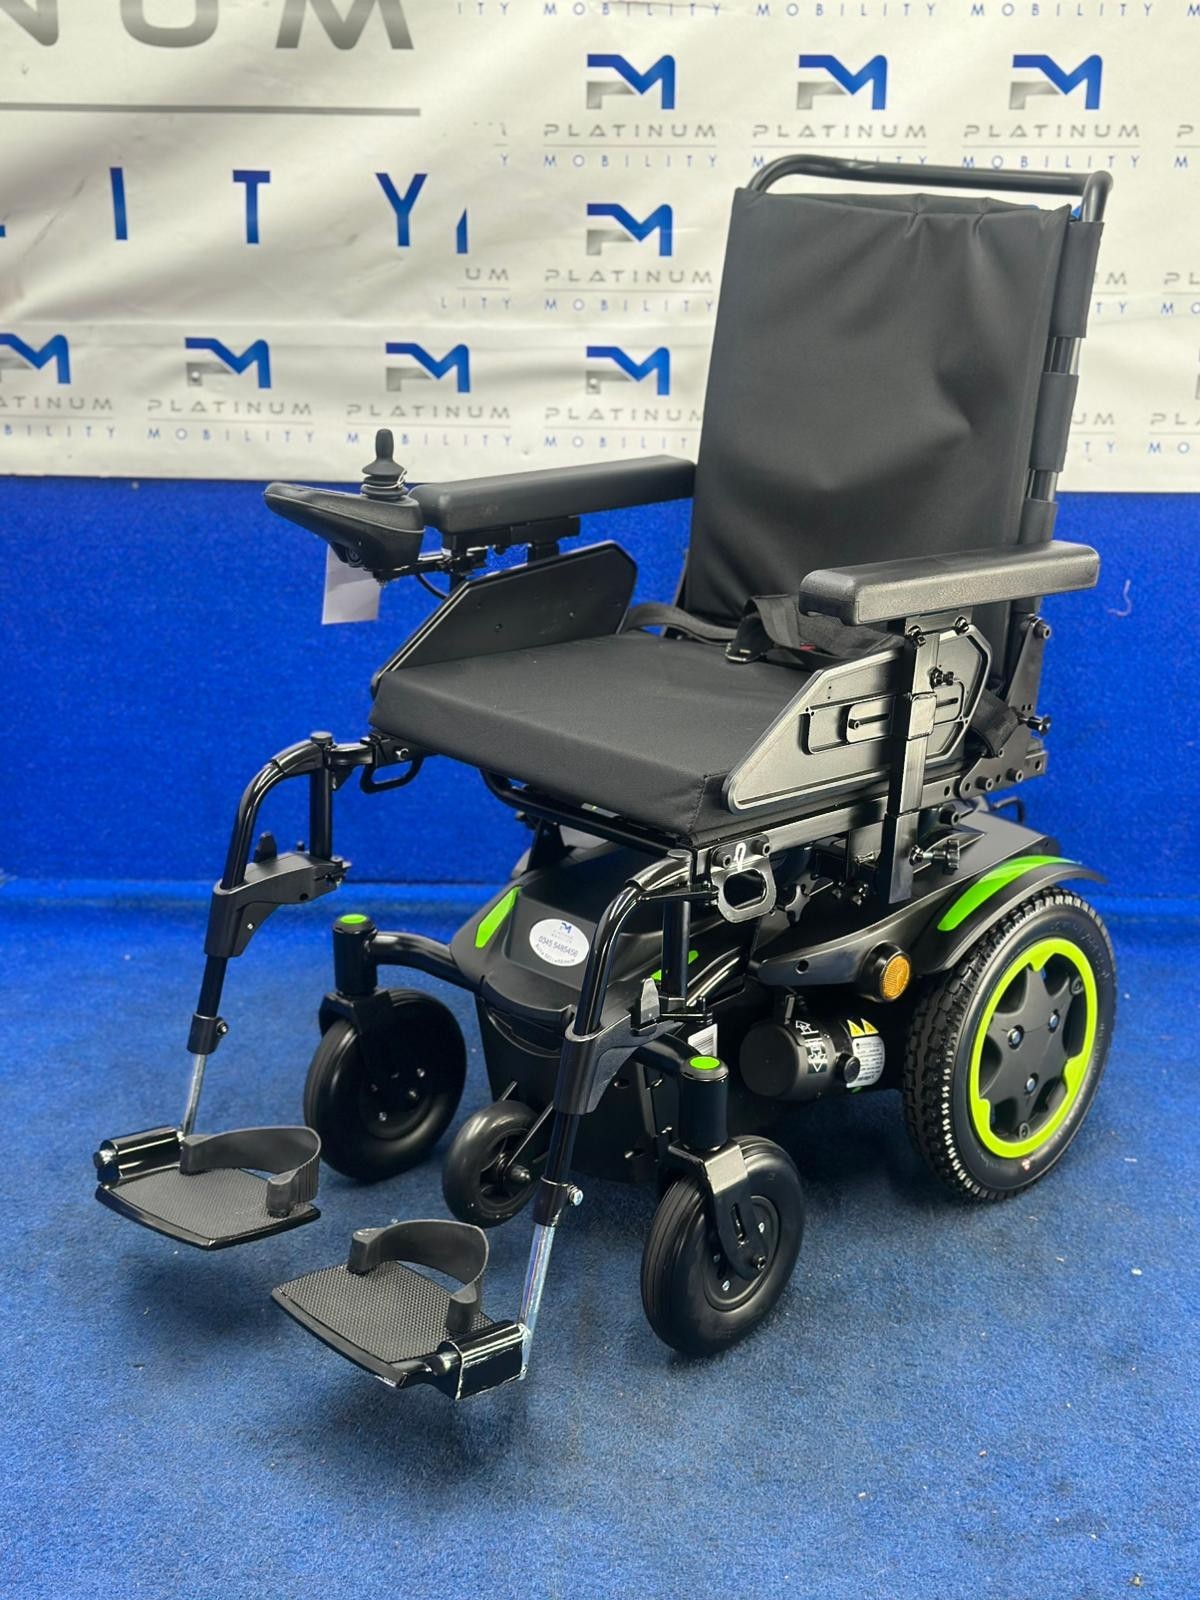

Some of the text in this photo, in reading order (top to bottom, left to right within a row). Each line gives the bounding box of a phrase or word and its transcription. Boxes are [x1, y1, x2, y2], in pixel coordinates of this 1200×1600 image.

[543, 2, 721, 17] MOBILITY
[757, 3, 936, 17] MOBILITY
[970, 3, 1153, 17] MOBILITY
[543, 123, 717, 138] PLATINUM
[752, 124, 927, 138] PLATINUM
[963, 124, 1140, 138] PLATINUM
[543, 154, 717, 167] MOBILITY
[962, 155, 1141, 169] MOBILITY
[0, 167, 428, 247] ITY
[544, 269, 713, 283] PLATINUM
[544, 299, 714, 312] MOBILITY
[147, 400, 313, 415] PLATINUM
[346, 404, 511, 419] PLATINUM
[148, 427, 314, 443] MOBILITY
[346, 432, 513, 446] MBILITY
[544, 435, 697, 449] MOBILIT
